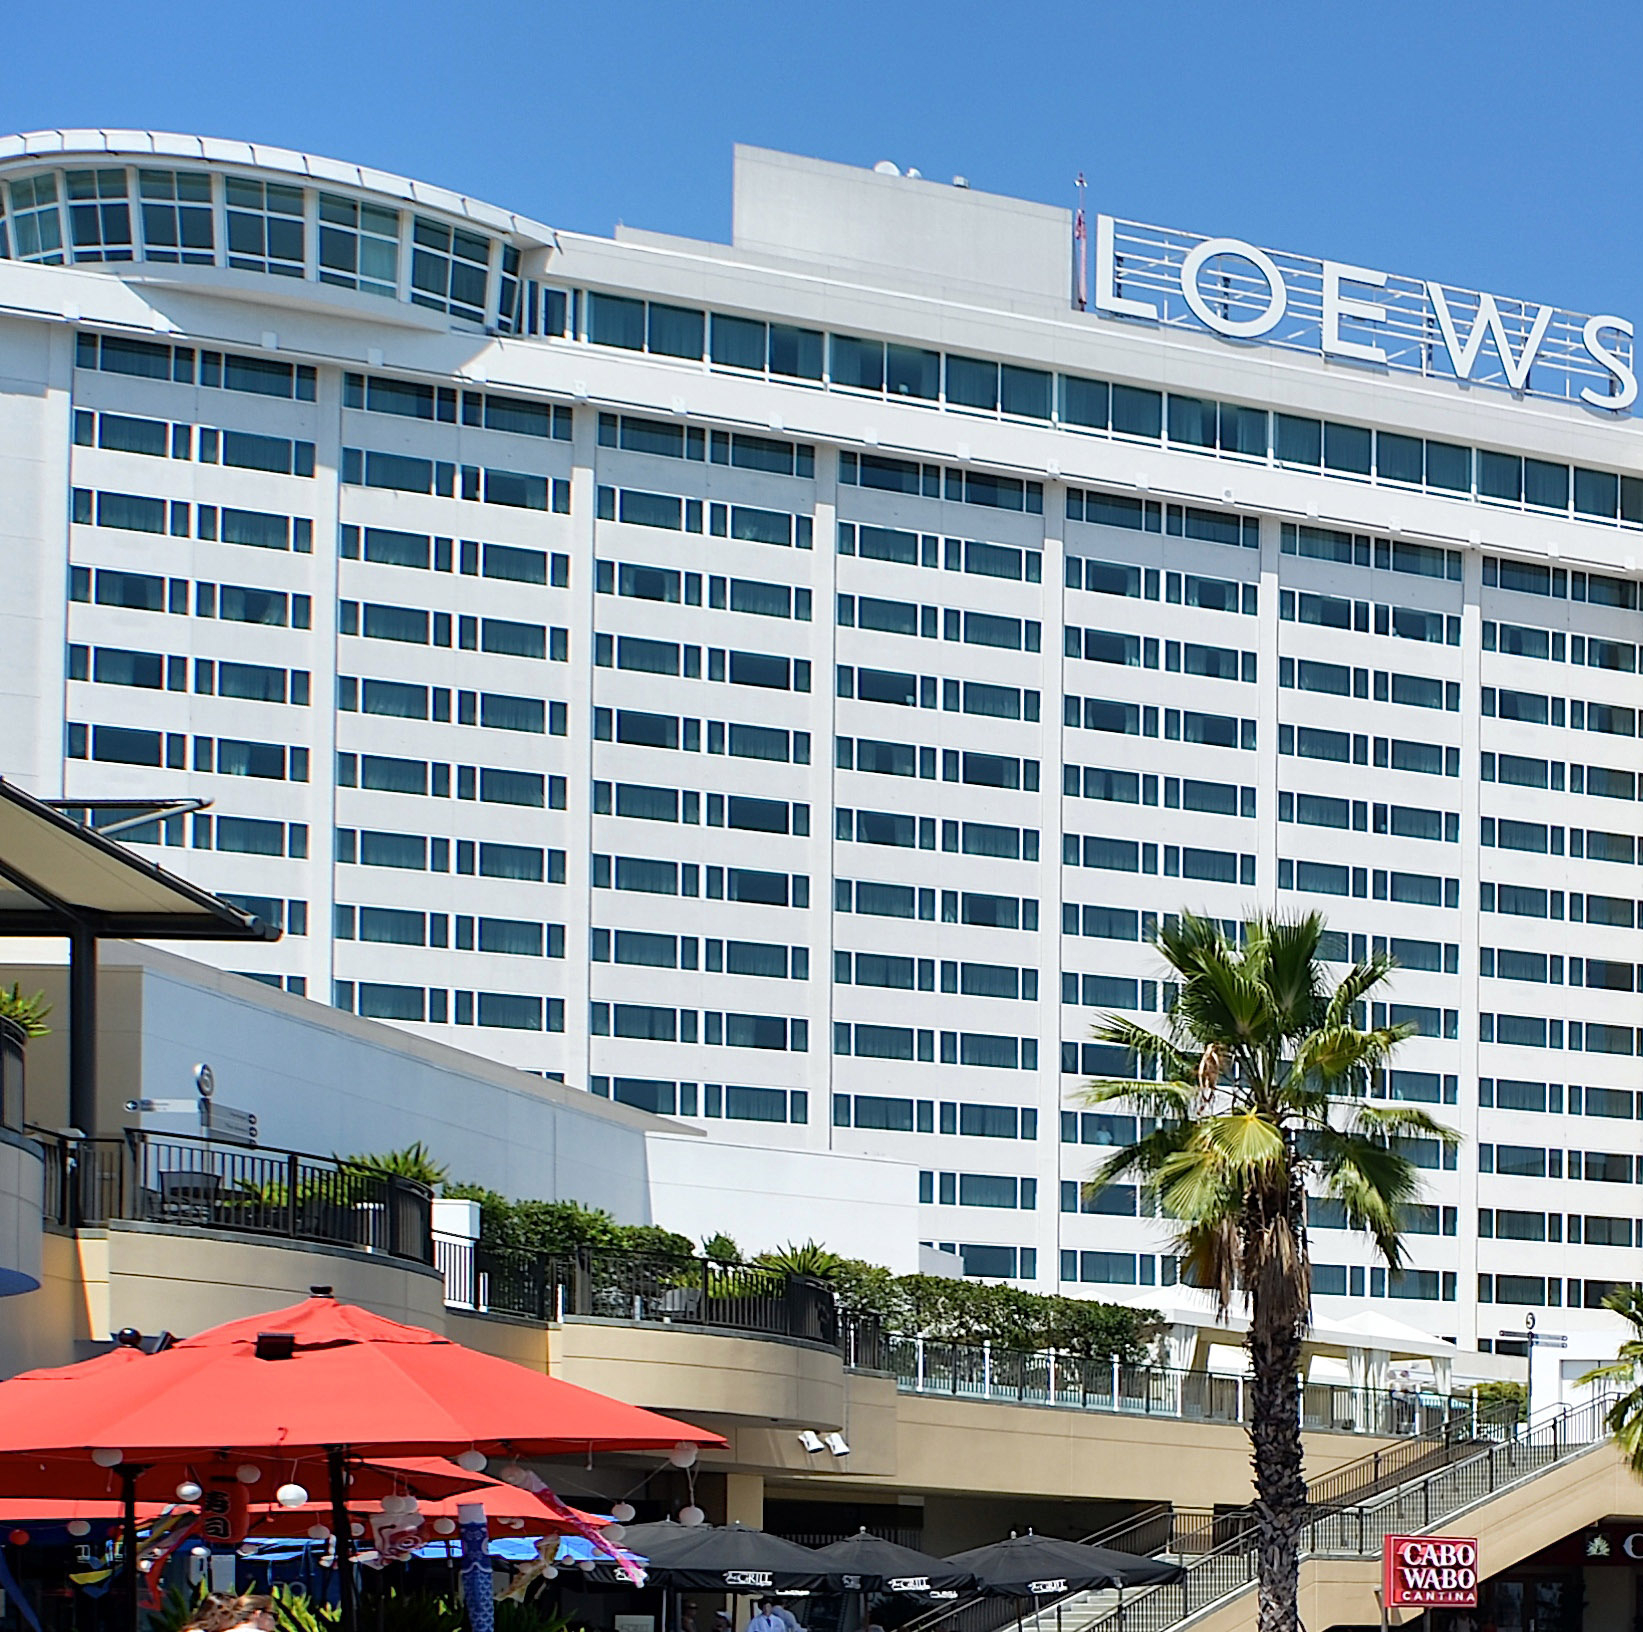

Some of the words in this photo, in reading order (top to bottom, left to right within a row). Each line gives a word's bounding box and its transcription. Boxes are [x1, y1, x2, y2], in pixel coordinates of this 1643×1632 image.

[1095, 213, 1639, 410] LOEWS
[1403, 1542, 1475, 1567] CABO
[1403, 1568, 1475, 1590] WABO
[1402, 1592, 1476, 1601] CANTINA
